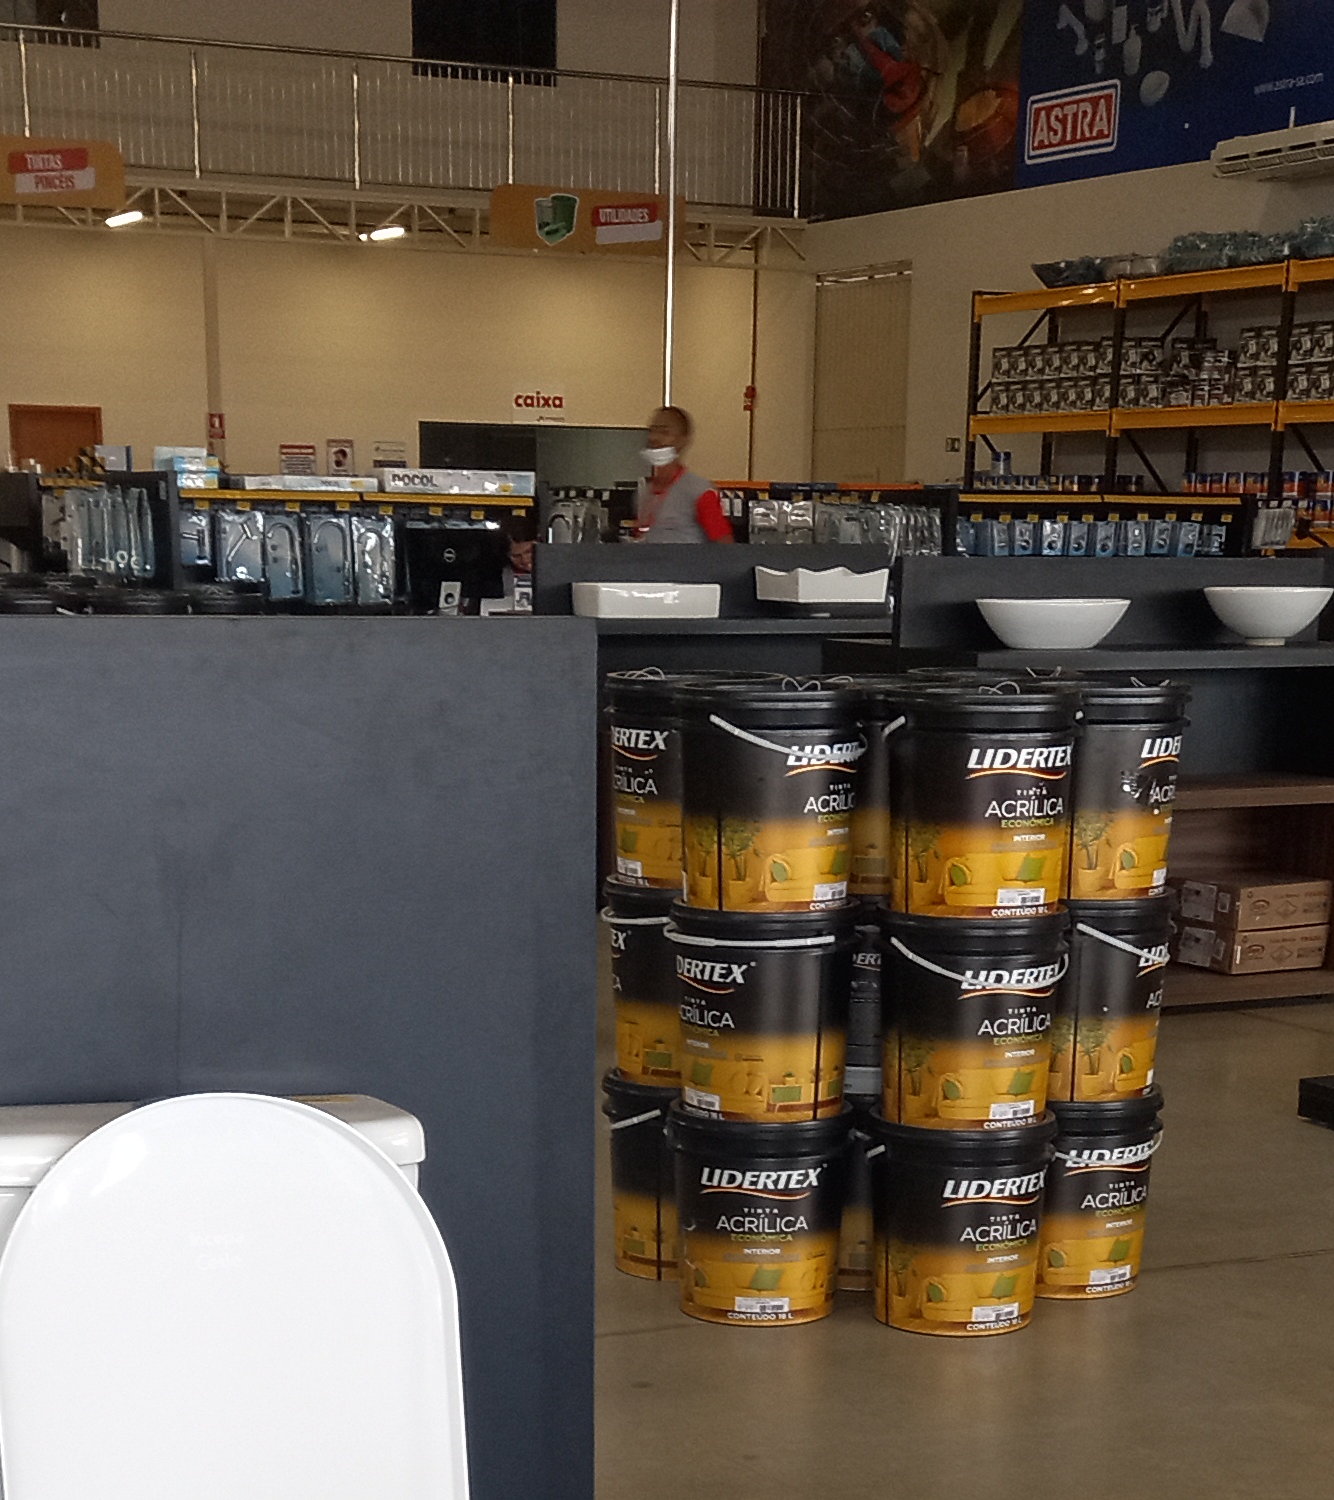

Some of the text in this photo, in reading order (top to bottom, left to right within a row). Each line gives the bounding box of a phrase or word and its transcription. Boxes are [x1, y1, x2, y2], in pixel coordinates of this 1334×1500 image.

[1033, 99, 1111, 147] ASTRA
[514, 391, 564, 409] caixa
[984, 796, 1064, 819] ACRÍLICA
[978, 1012, 1052, 1037] ACRÍLICA
[701, 1166, 824, 1190] LIDERTEX
[1081, 1184, 1148, 1210] ACRÍLICA
[716, 1214, 809, 1233] ACRÍLICA
[960, 1218, 1037, 1243] ACRÍLICA
